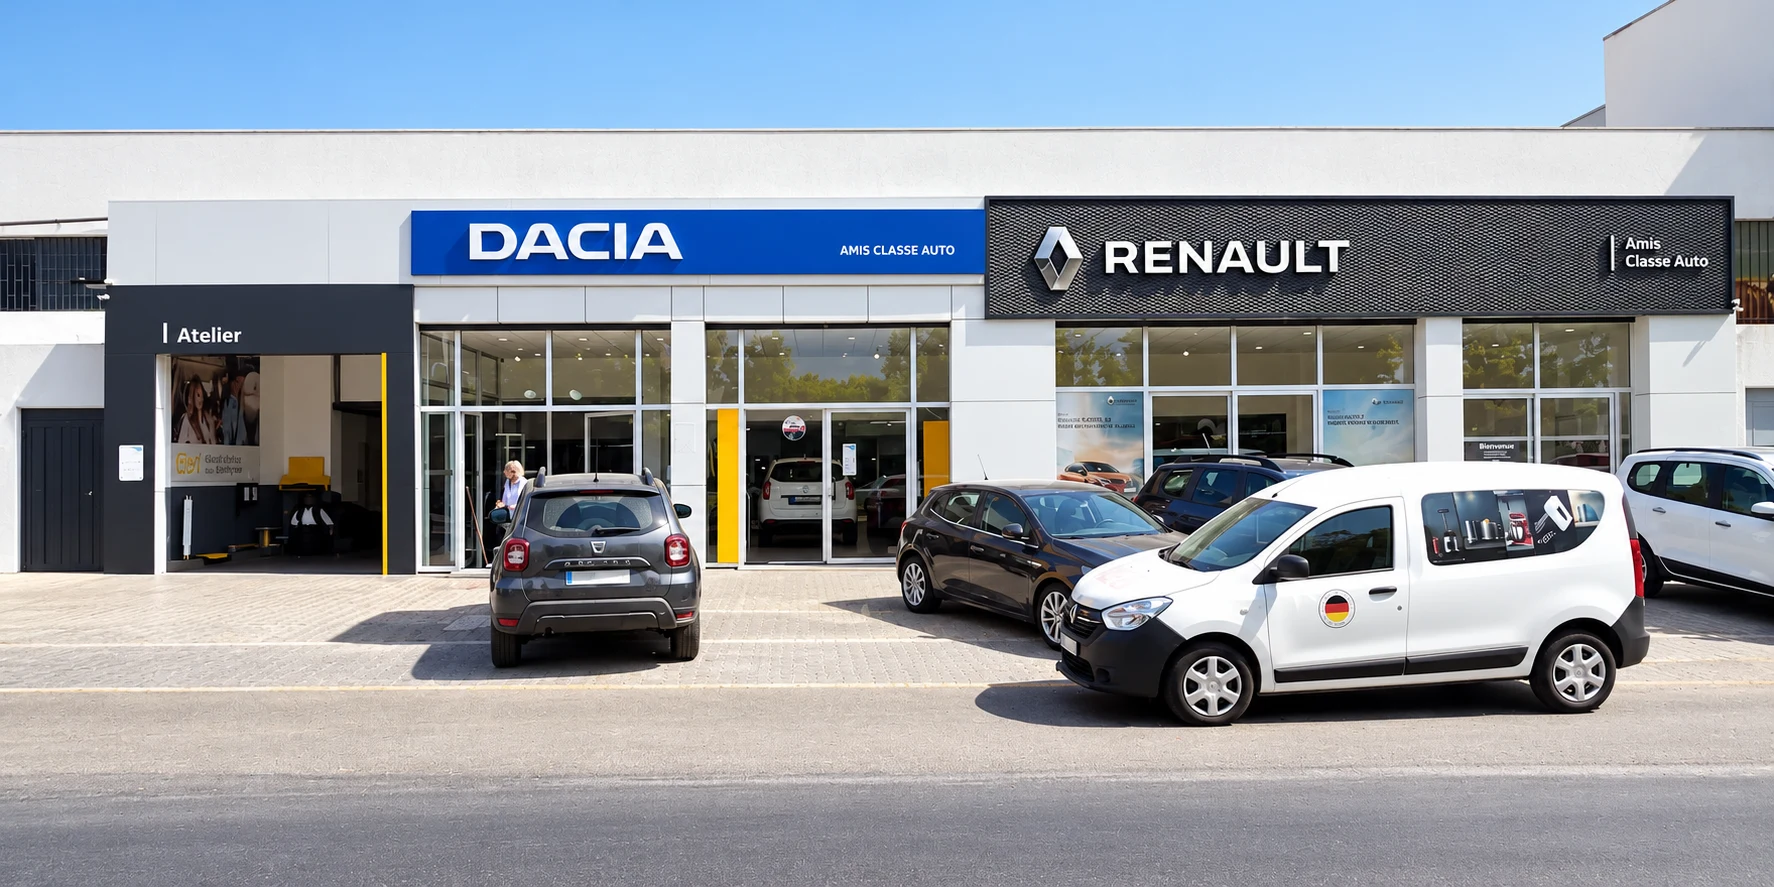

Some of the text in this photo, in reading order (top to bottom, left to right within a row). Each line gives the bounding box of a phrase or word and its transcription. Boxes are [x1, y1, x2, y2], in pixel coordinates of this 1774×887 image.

[469, 222, 683, 260] DACIA
[1625, 236, 1661, 250] Amis
[840, 245, 955, 256] AMIS CLASSE AUTO
[1105, 239, 1350, 274] RENAULT
[1625, 254, 1709, 268] Classe Auto
[176, 326, 242, 343] Atelier
